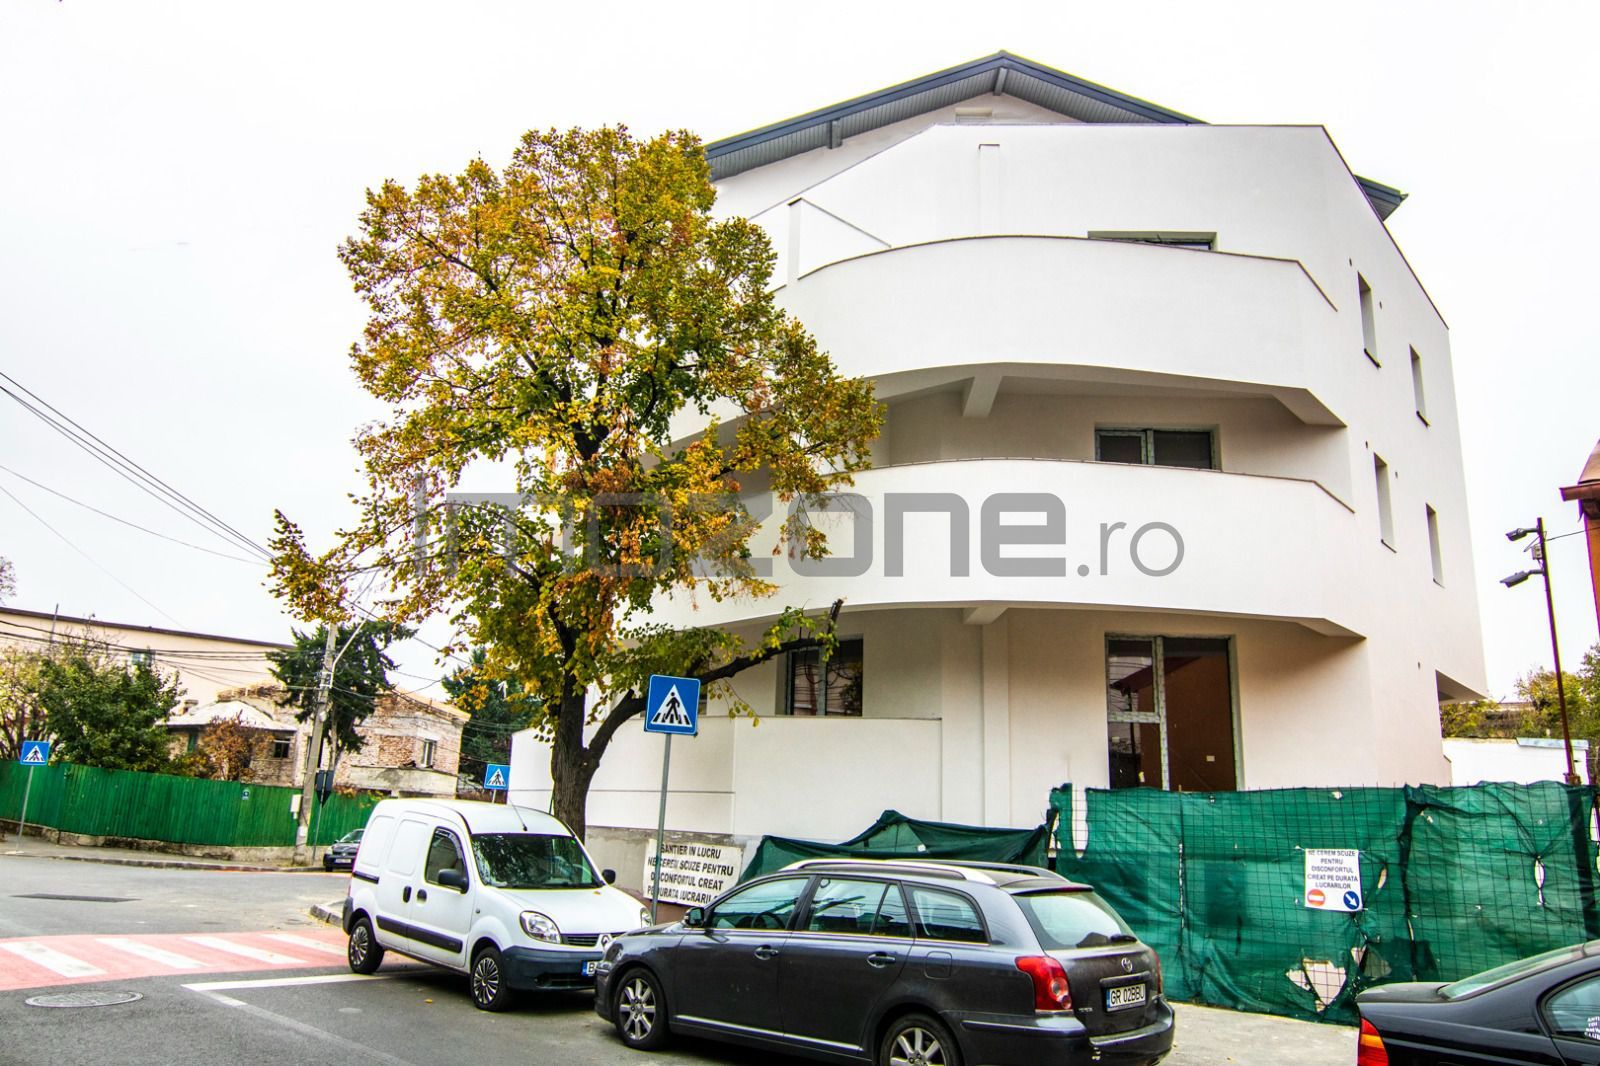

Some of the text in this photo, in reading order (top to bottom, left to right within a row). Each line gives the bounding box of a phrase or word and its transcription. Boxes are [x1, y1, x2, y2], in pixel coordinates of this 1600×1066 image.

[688, 846, 696, 856] IN
[697, 848, 721, 859] LUCRU
[647, 856, 734, 877] NE EREM SCUZE PENTRU
[650, 871, 724, 891] DCONFORTUL CREAT
[659, 887, 679, 899] URATA
[1111, 985, 1145, 1005] GR 02BBJ
